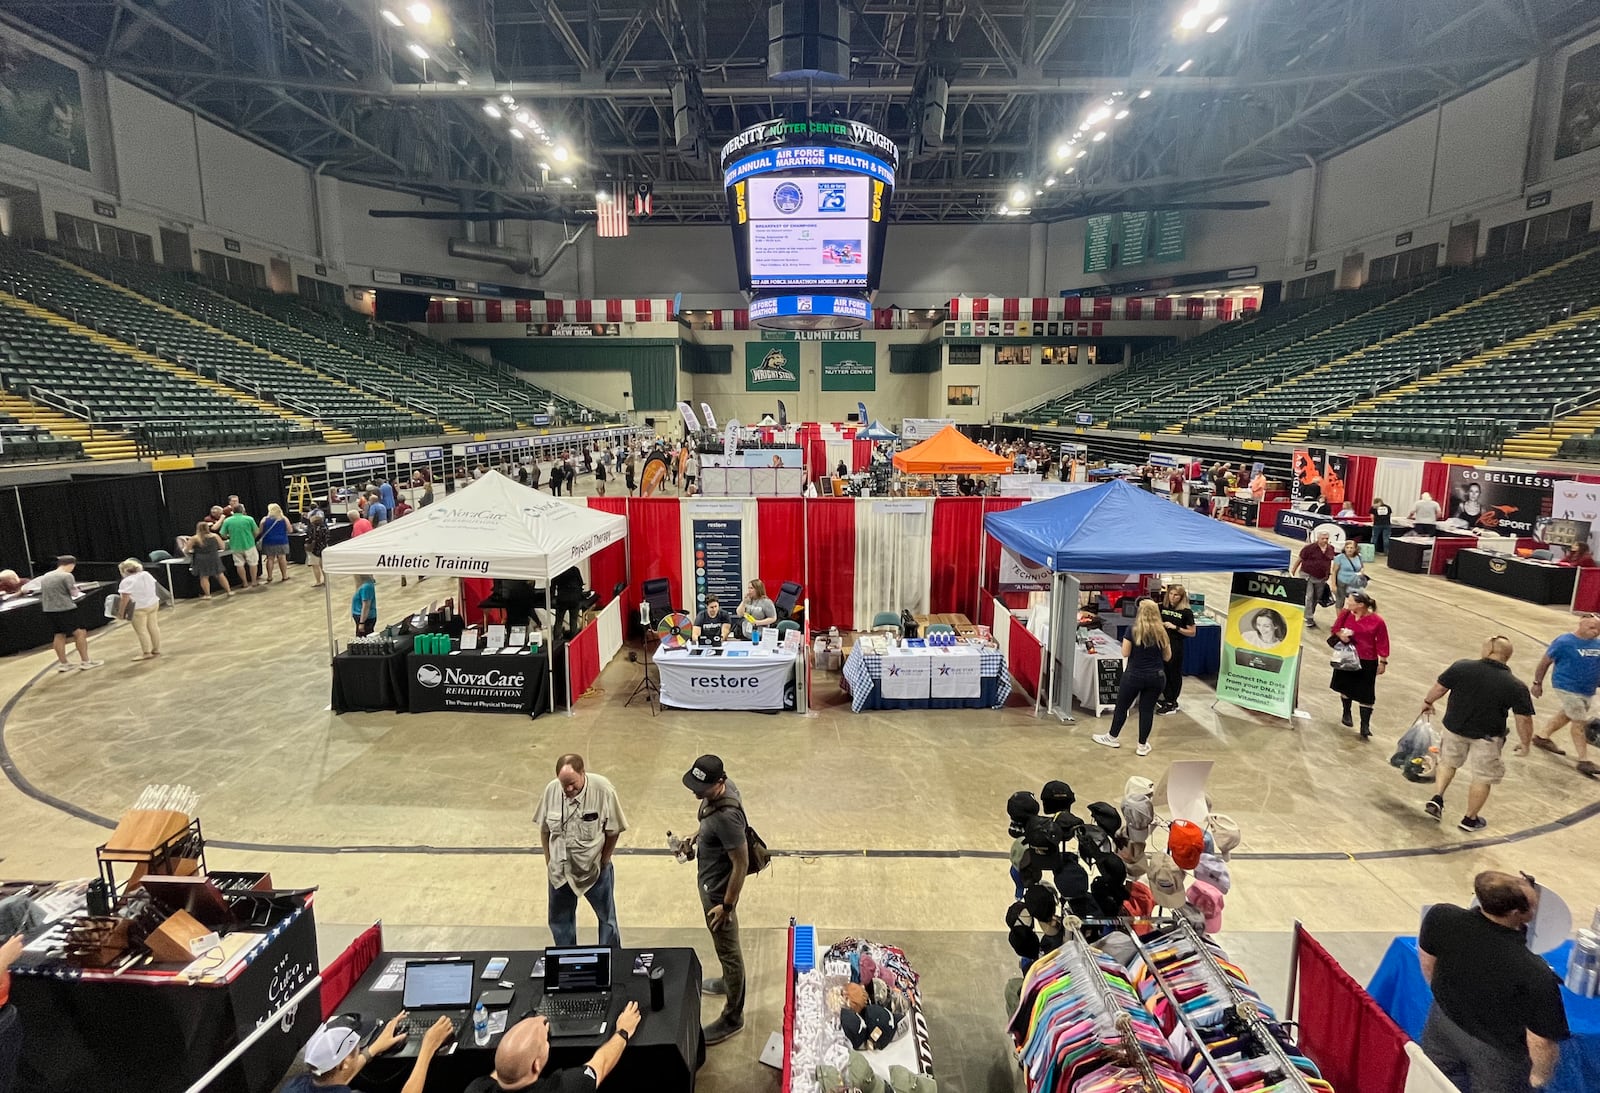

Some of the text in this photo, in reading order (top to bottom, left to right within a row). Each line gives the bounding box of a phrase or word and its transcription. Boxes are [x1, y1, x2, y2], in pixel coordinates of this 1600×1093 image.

[769, 122, 807, 136] NUTTER
[809, 123, 847, 135] CENTER
[851, 124, 894, 154] WRIGHT
[776, 149, 825, 159] AIR FORCE
[776, 157, 825, 167] MARATHON
[738, 157, 772, 175] ANNUAL
[829, 154, 869, 170] HEALTH
[870, 163, 877, 172] &
[835, 298, 848, 306] AIR
[794, 331, 832, 340] ALUMNI
[834, 331, 860, 340] ZONE
[345, 456, 384, 469] REGISTRATION
[1462, 470, 1479, 479] GO
[376, 554, 490, 573] Athletic Training
[1012, 564, 1054, 580] TECHNIQU
[1248, 580, 1288, 598] DNA
[444, 668, 524, 687] NovaCare
[691, 674, 758, 688] restore
[1228, 672, 1254, 682] Connect
[1270, 680, 1285, 688] Dots
[445, 687, 522, 697] REHABILITATION
[1260, 686, 1276, 694] DNA
[274, 954, 288, 973] THE
[256, 963, 312, 1028] KITCHEN
